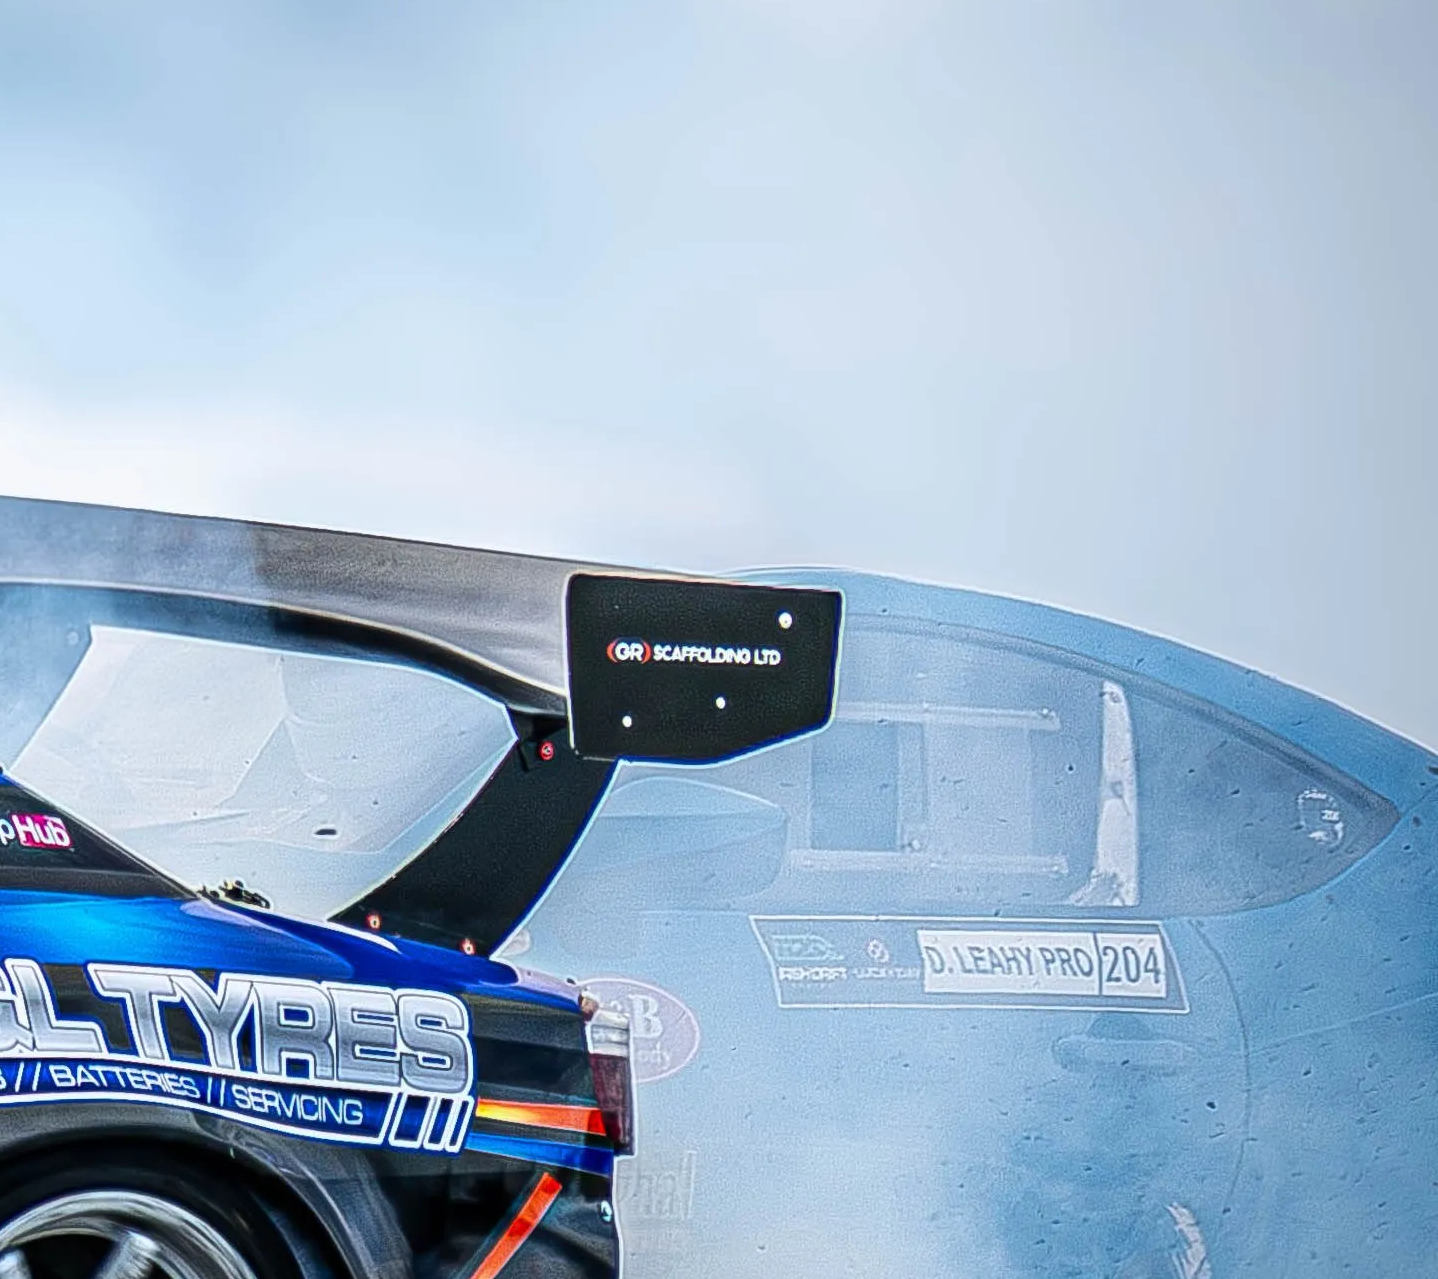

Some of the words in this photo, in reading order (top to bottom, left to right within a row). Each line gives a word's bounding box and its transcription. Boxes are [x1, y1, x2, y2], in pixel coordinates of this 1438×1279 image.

[653, 645, 751, 664] SCAFFOLDING
[754, 648, 781, 665] LTD
[924, 946, 953, 976] D.
[961, 946, 1036, 978] LEAHY
[1043, 948, 1094, 979] PRO
[1103, 945, 1162, 984] 204
[88, 964, 470, 1093] TYRES
[48, 1064, 201, 1098] BATTERIES
[232, 1084, 364, 1125] SERVICING
